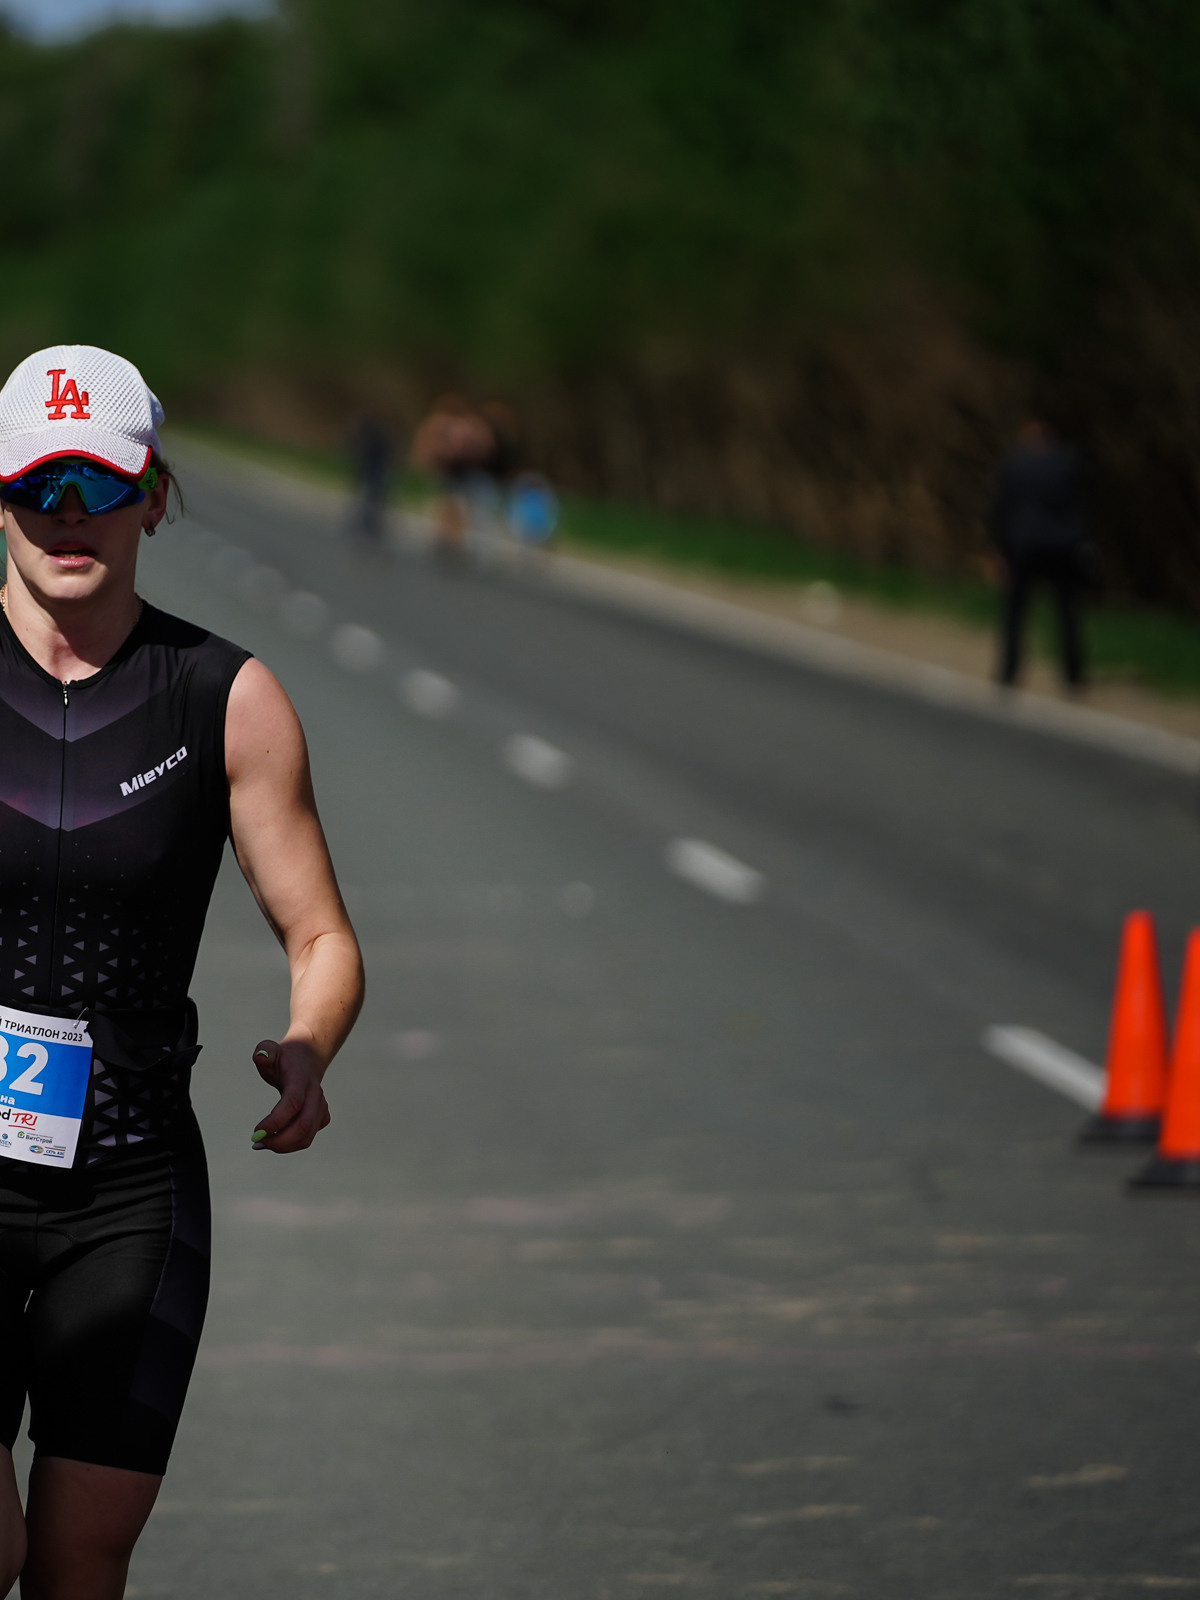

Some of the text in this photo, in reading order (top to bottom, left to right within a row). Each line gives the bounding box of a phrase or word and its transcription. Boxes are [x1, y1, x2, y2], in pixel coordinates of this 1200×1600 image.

[45, 369, 90, 420] LA
[119, 746, 188, 797] Mieyco
[4, 1019, 60, 1040] ТРИАТЛОН
[61, 1031, 83, 1042] 2023
